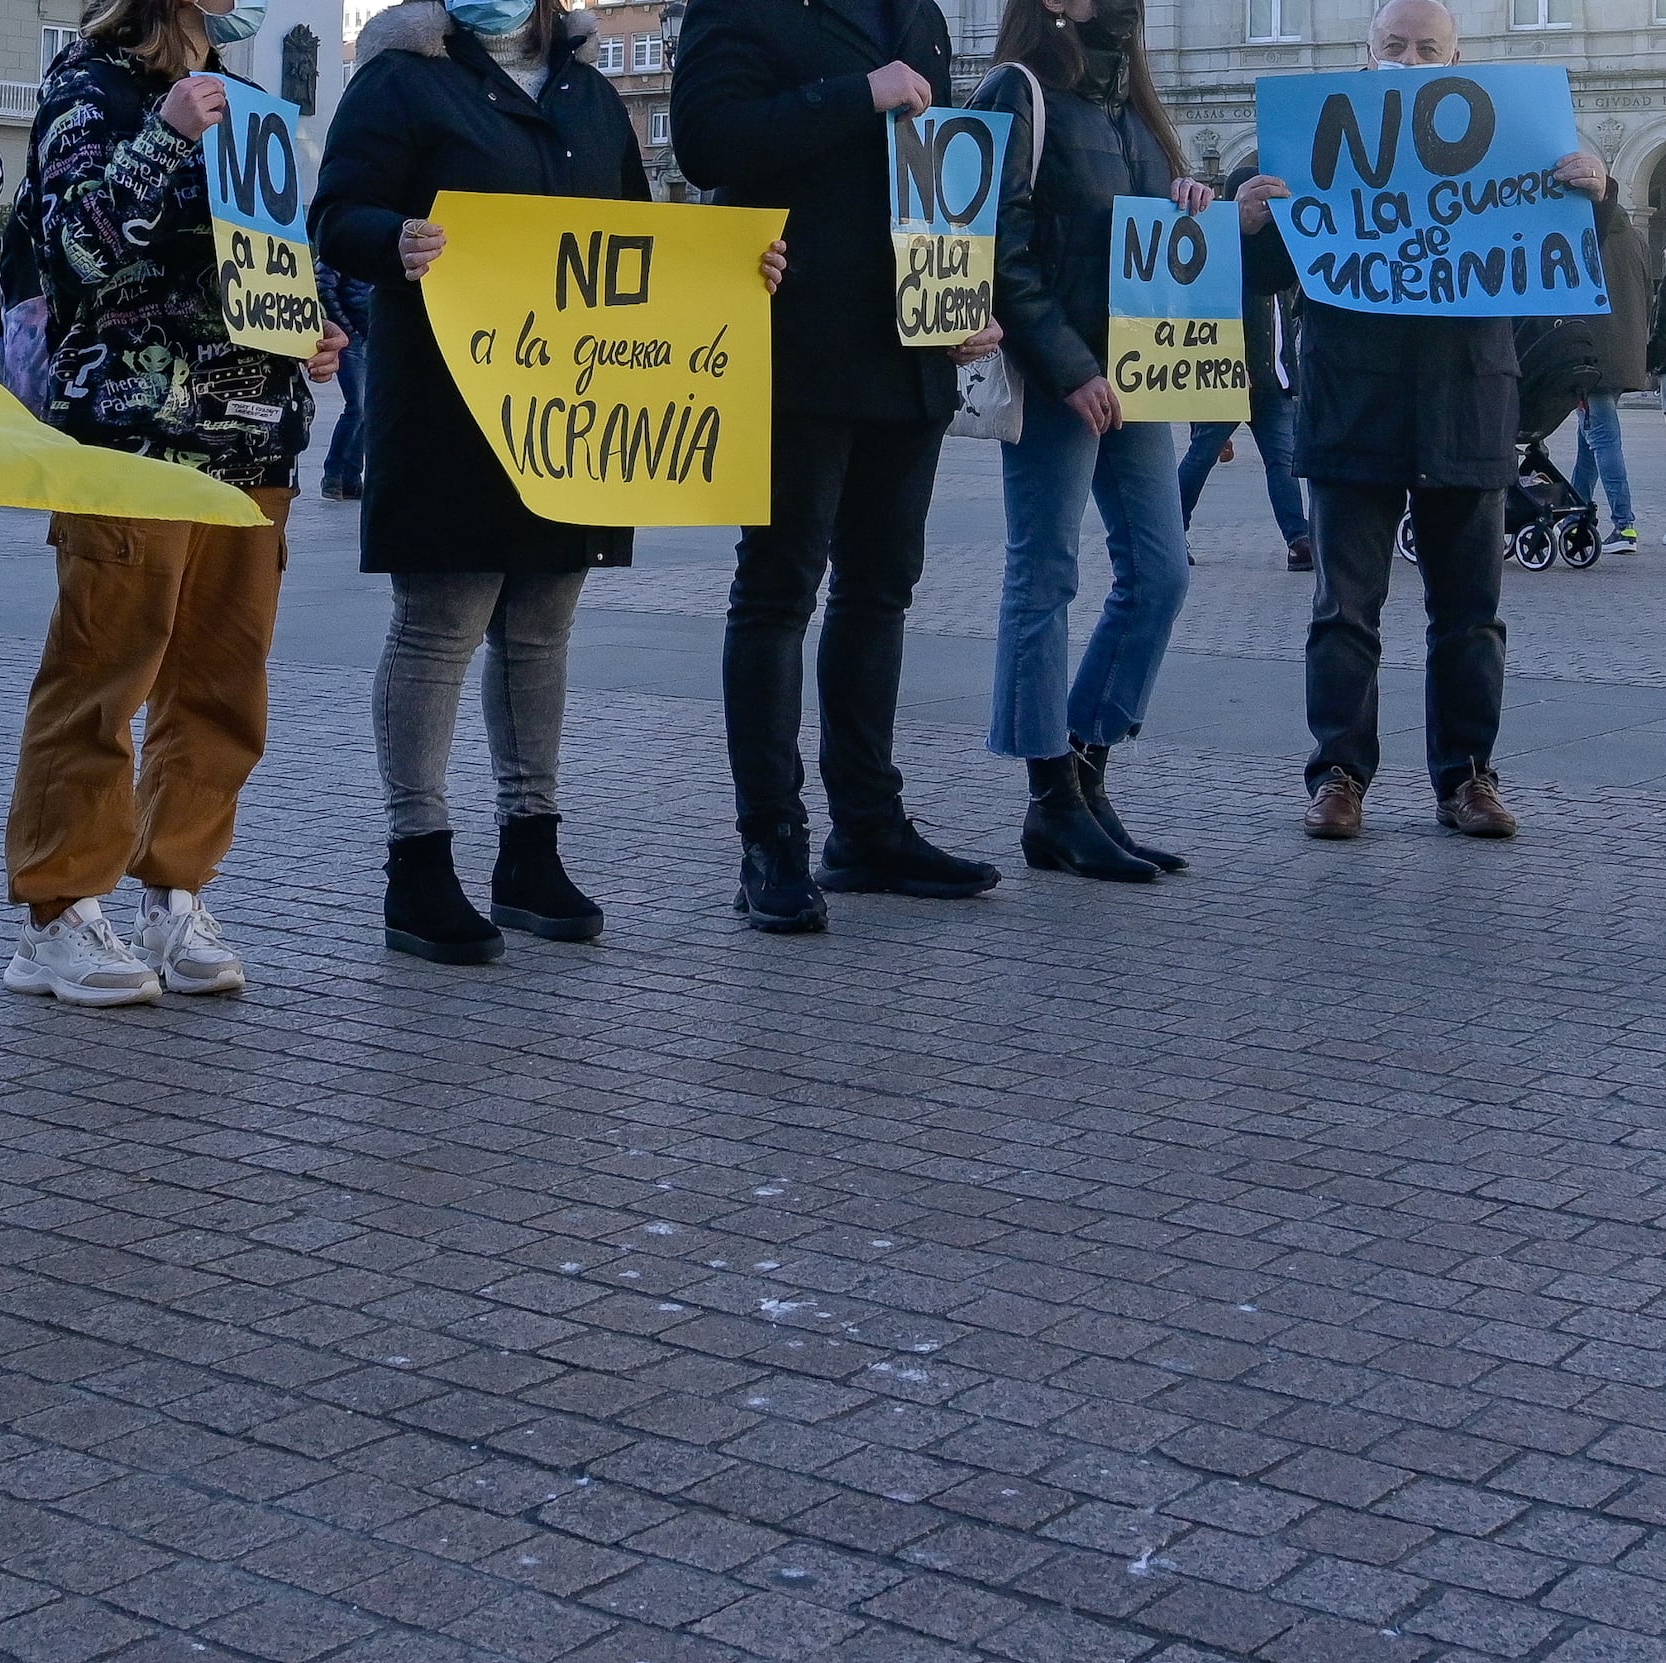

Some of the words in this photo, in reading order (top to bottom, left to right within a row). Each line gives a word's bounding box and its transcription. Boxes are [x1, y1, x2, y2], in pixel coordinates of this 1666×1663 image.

[1186, 109, 1225, 120] CASAS
[1310, 76, 1496, 191] NO
[218, 100, 298, 227] NO
[896, 116, 994, 227] NO
[1290, 196, 1337, 238] a
[232, 231, 255, 269] a
[556, 231, 654, 312] NO
[910, 236, 934, 278] a
[1122, 217, 1208, 286] NO
[1398, 226, 1451, 263] de
[471, 329, 496, 365] a
[516, 311, 551, 368] la
[689, 324, 729, 378] de
[1154, 320, 1175, 348] a
